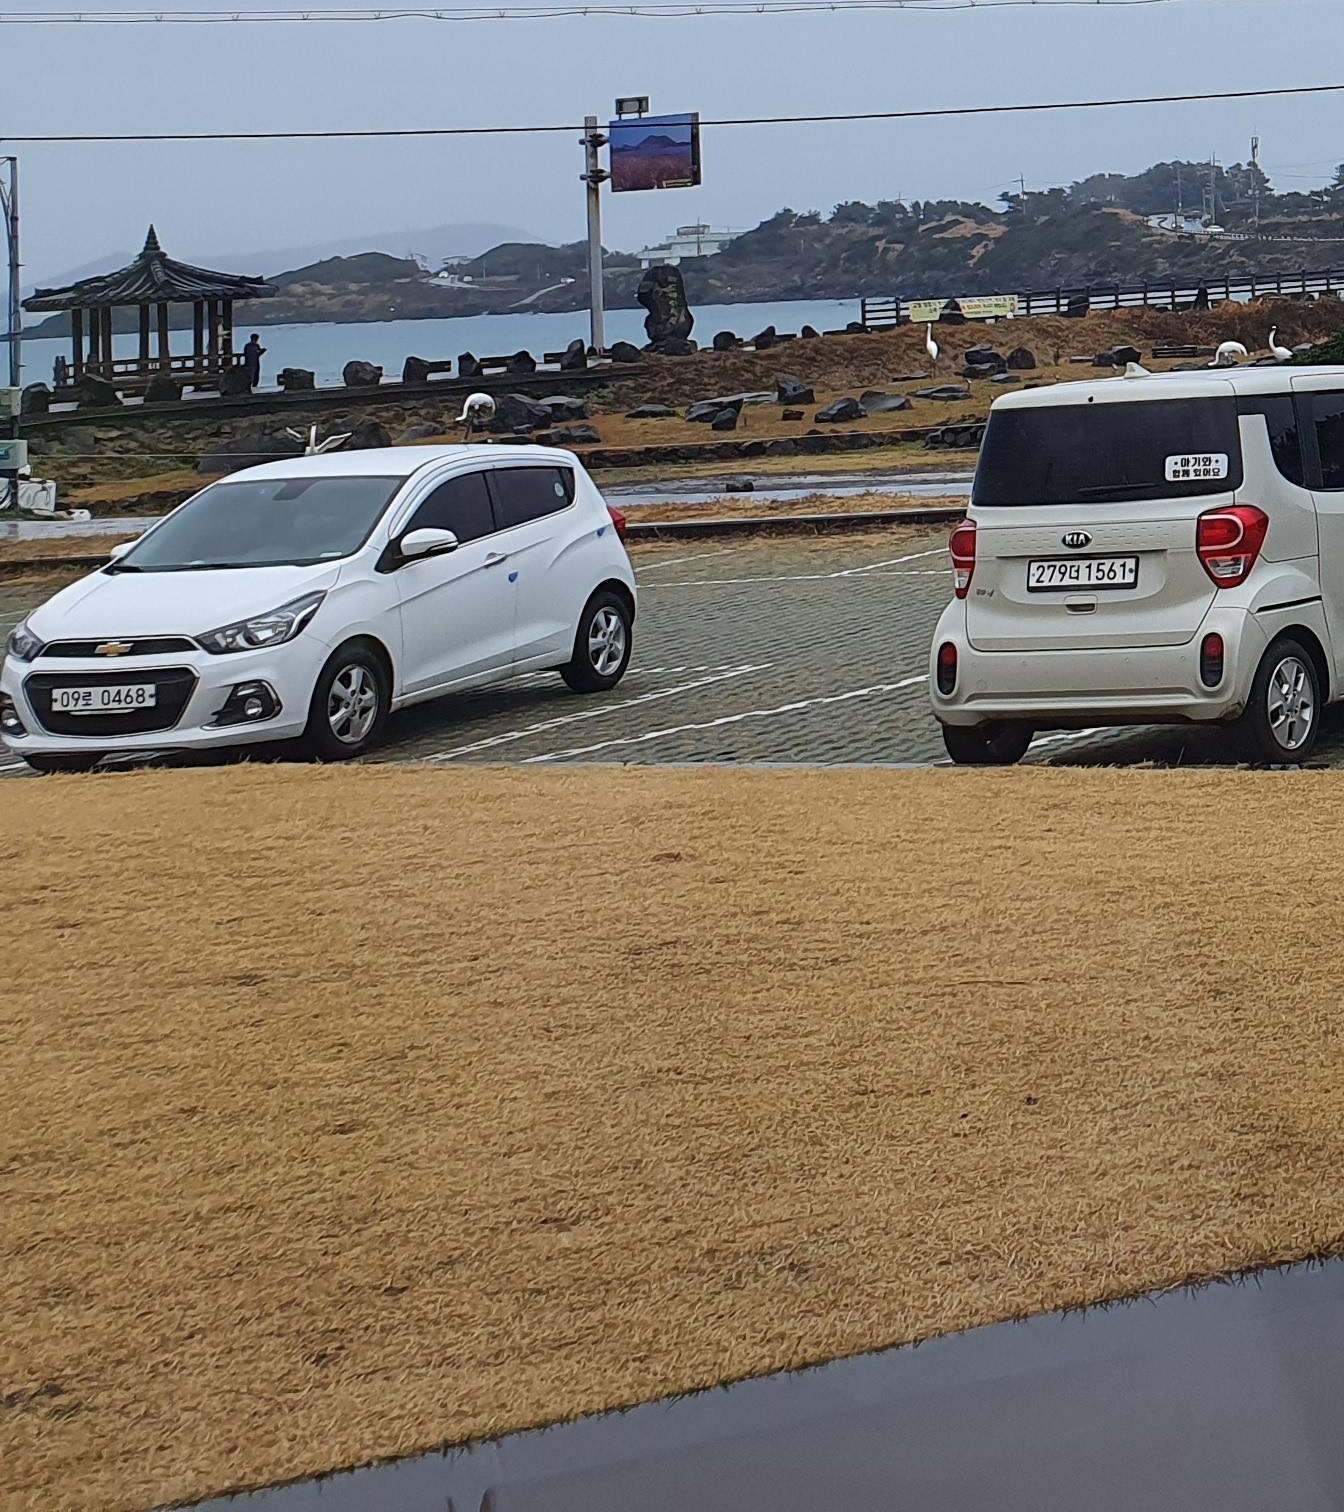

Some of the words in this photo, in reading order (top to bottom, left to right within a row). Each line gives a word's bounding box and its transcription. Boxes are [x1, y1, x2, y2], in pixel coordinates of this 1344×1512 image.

[1181, 456, 1212, 467] 아기와
[1065, 534, 1086, 545] KIA
[1035, 564, 1080, 584] 279더
[1085, 561, 1127, 581] 1561
[61, 691, 92, 708] 09로
[101, 687, 146, 706] 0468
